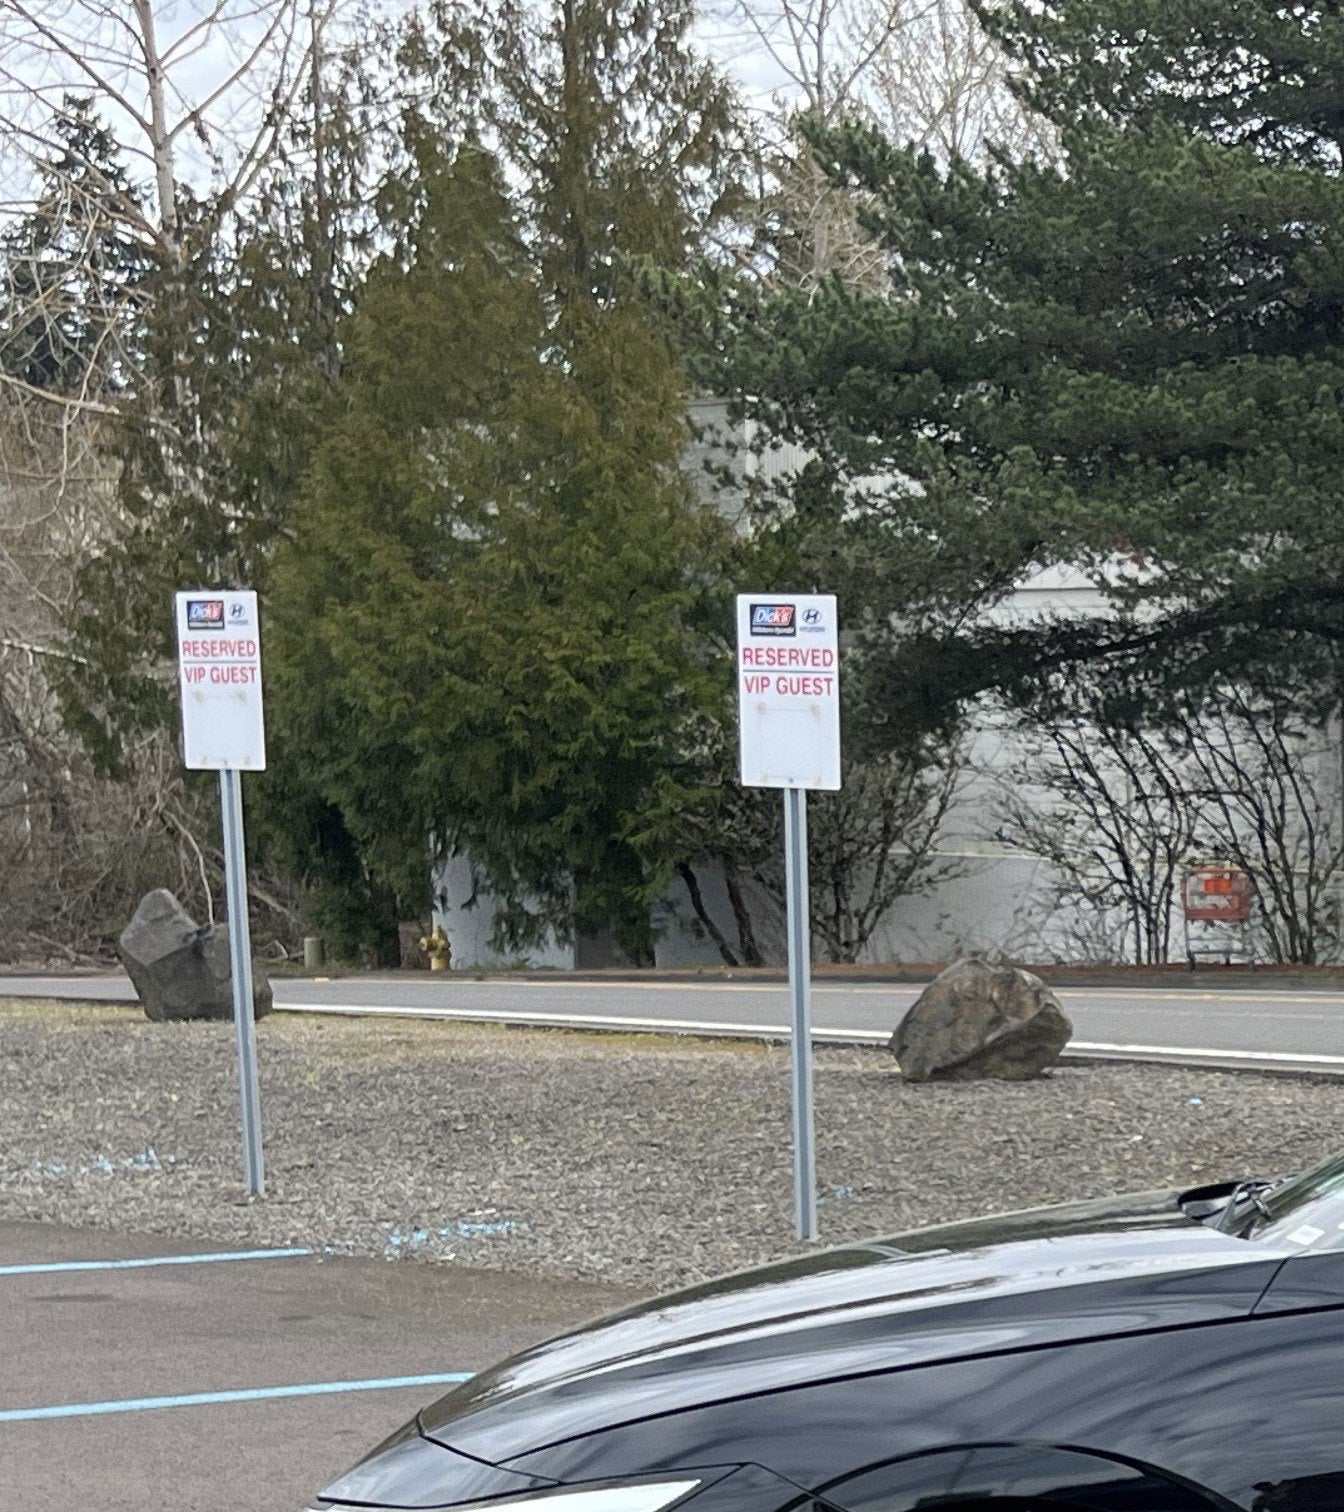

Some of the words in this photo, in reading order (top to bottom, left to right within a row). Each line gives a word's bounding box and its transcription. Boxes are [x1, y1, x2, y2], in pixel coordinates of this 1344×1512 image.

[182, 639, 256, 658] RESERVED
[742, 647, 834, 668] RESERVED
[183, 666, 206, 684] VIP
[210, 666, 257, 685] GUEST
[744, 676, 771, 695] VIP
[776, 676, 834, 696] GUEST
